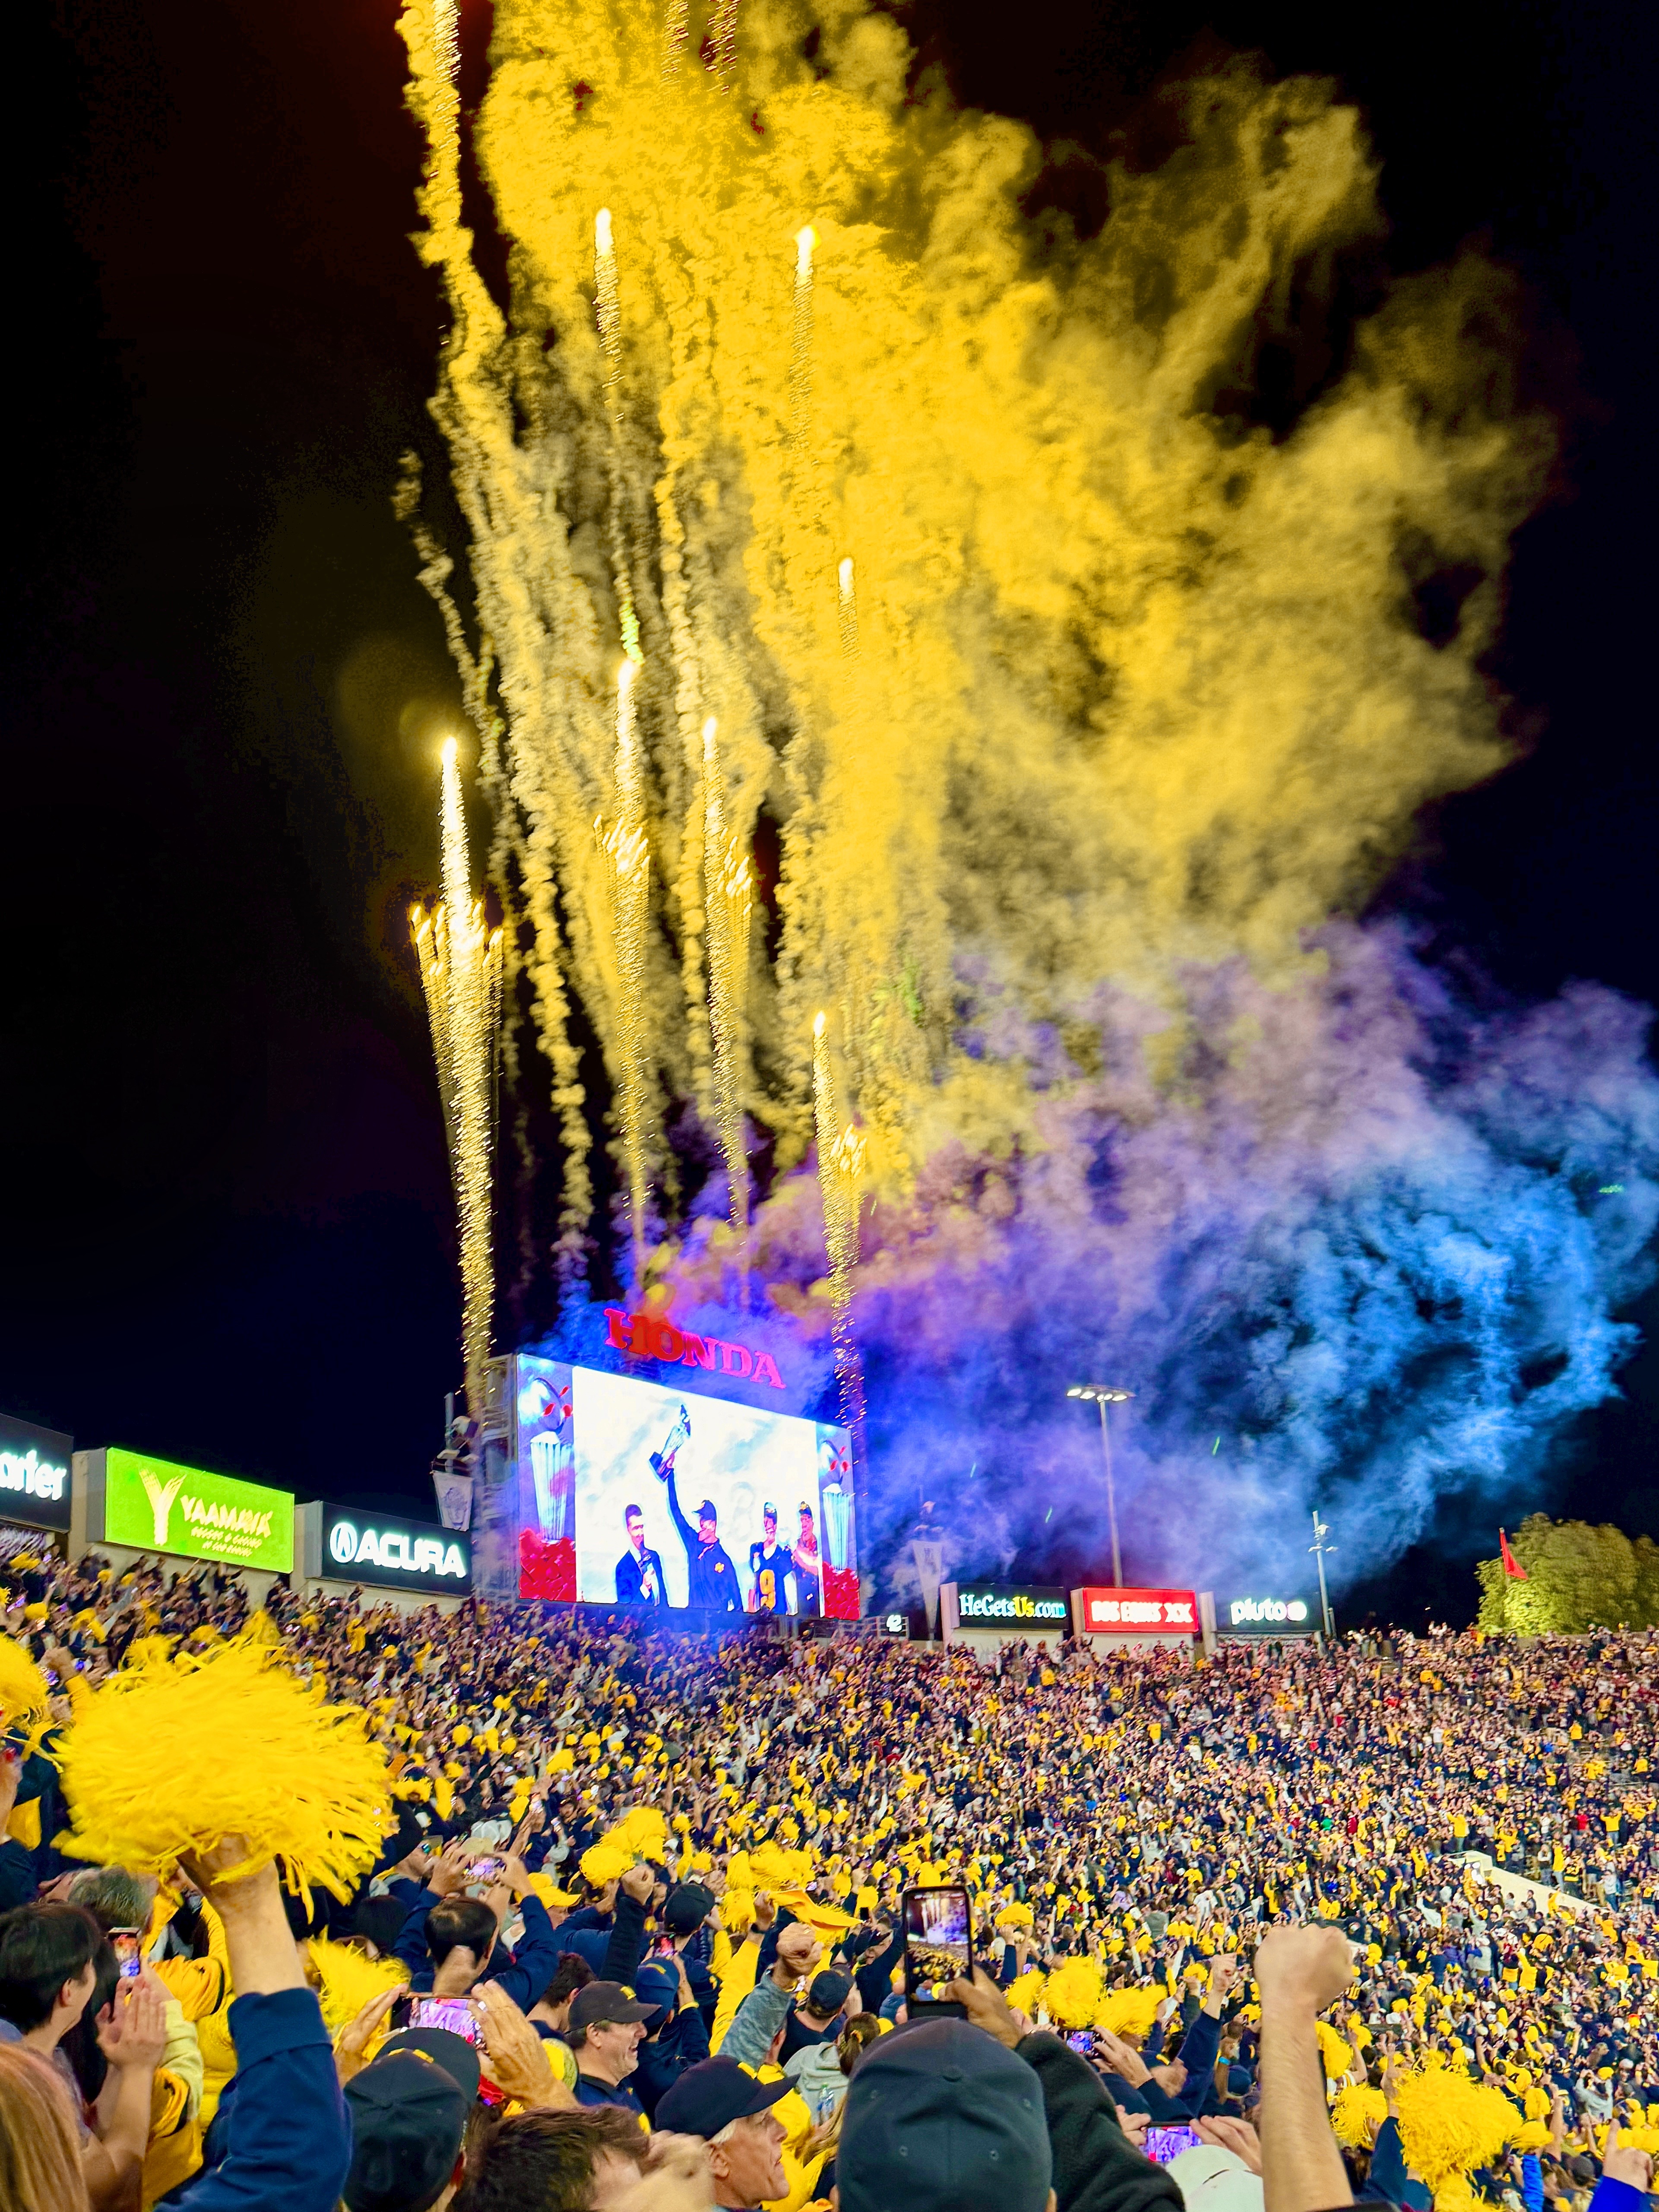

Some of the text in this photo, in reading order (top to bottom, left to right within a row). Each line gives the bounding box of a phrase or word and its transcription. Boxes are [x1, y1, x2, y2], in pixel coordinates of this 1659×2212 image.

[604, 1308, 786, 1388] HONDA
[354, 1529, 466, 1578] ACURA
[959, 1594, 1067, 1618] HeGetsUs.com
[1231, 1598, 1287, 1625] pluto
